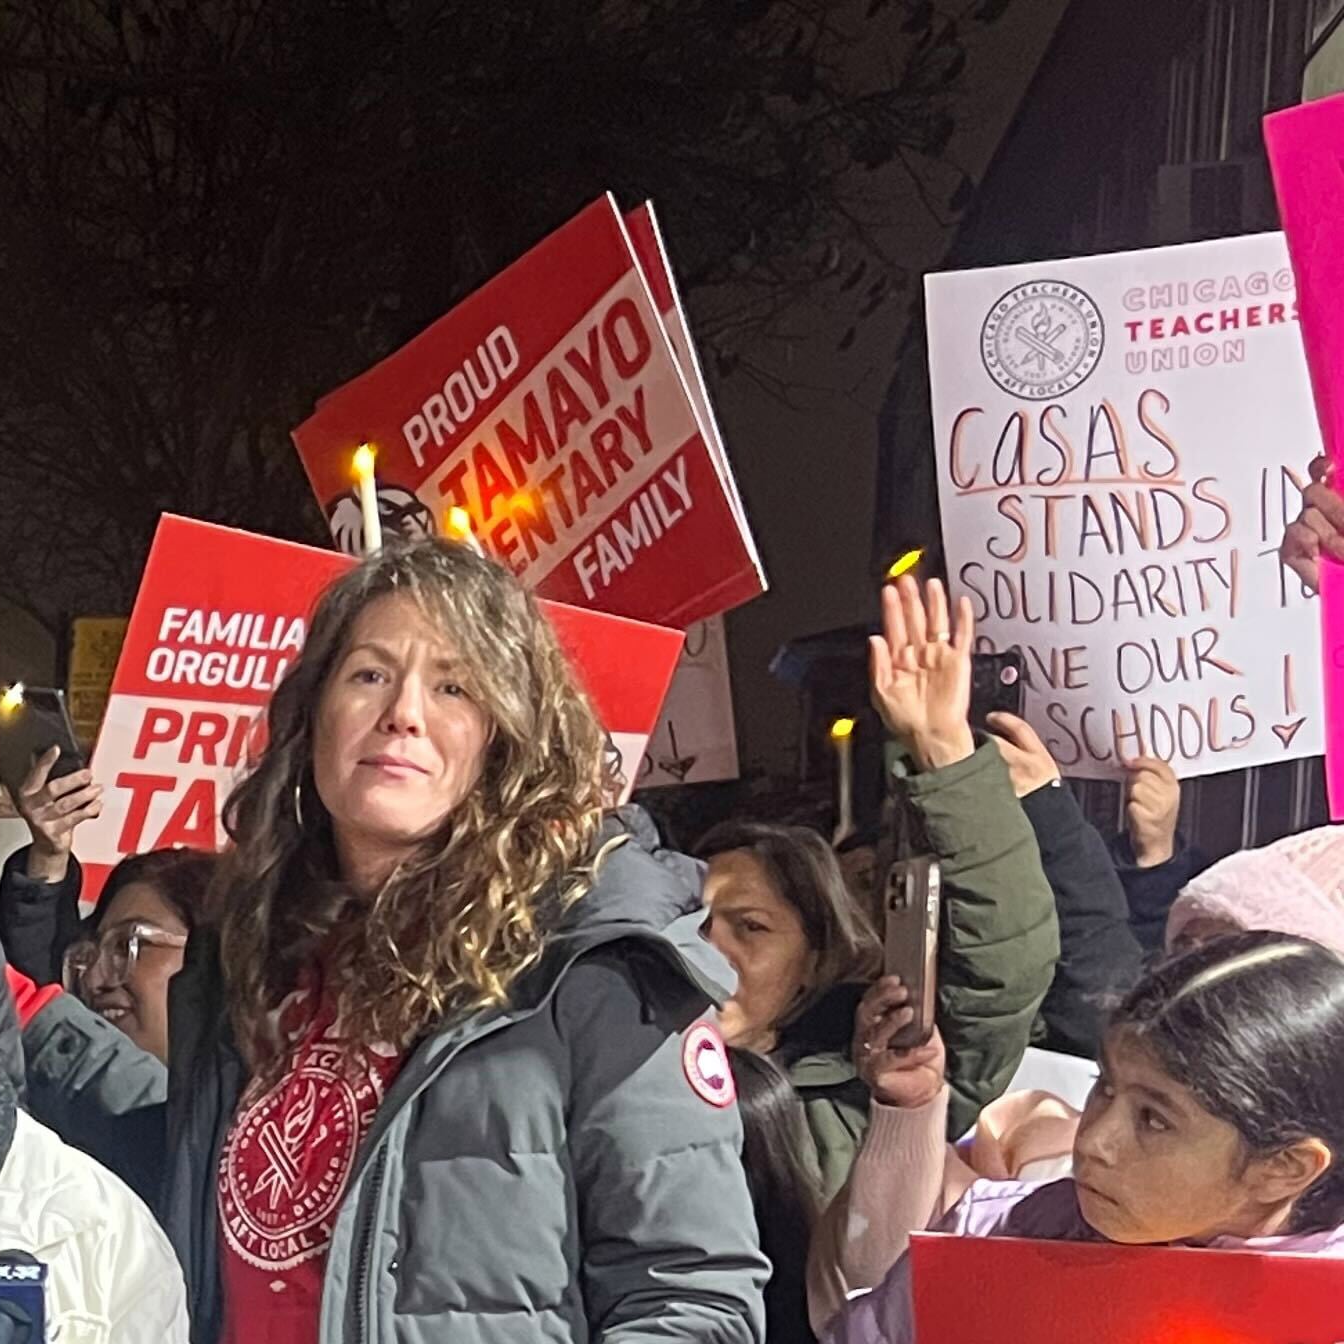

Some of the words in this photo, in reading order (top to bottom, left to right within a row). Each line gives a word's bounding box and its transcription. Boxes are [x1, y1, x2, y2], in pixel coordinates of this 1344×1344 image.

[1123, 268, 1295, 312] CHICAGO
[1029, 379, 1072, 396] LOCAL
[1125, 339, 1245, 375] UNION
[402, 325, 519, 468] PROUD
[438, 297, 651, 531] TAMAYO
[484, 385, 654, 577] ENTARY
[572, 456, 695, 599] FAMILY
[987, 477, 1231, 562] STANDS
[959, 550, 1240, 624] SOLIDARITY
[1257, 548, 1320, 607] T
[158, 607, 306, 651] FAMILIA
[975, 636, 1089, 694] AVE
[1116, 628, 1243, 694] OUR
[229, 1215, 258, 1248] AFT
[260, 1232, 314, 1258] LOCAL
